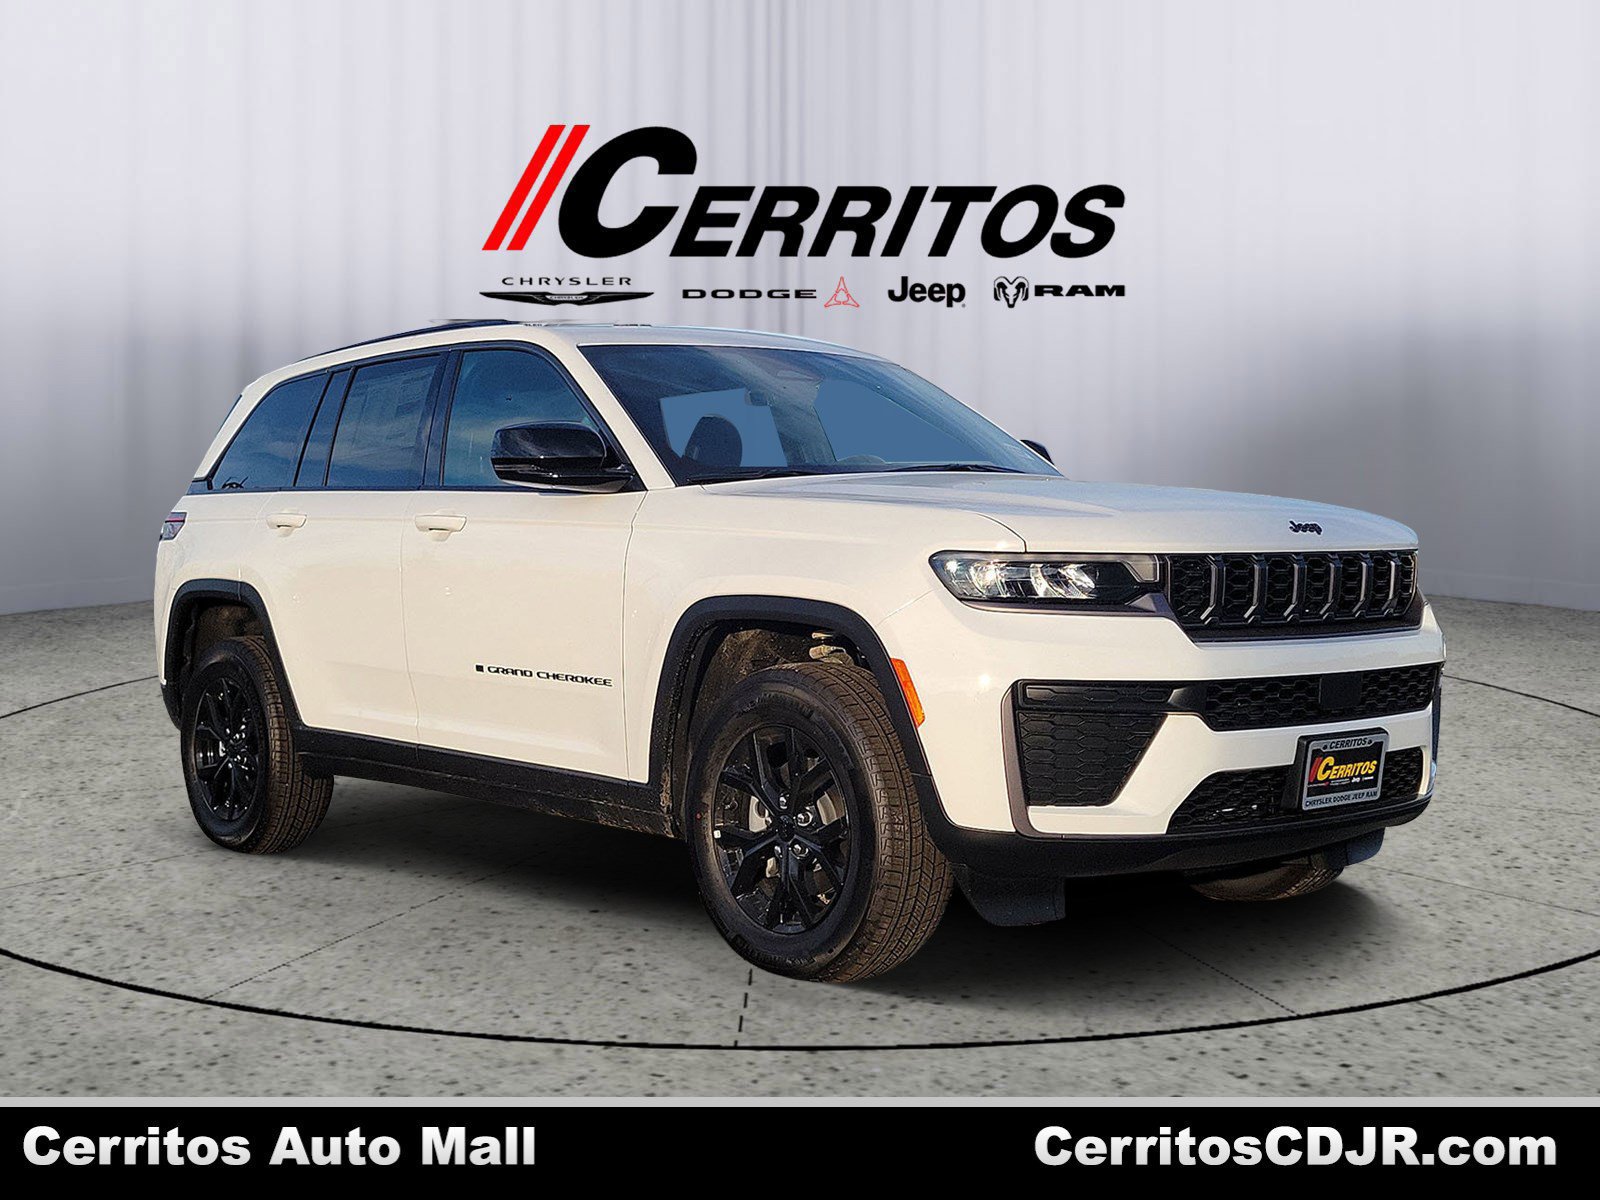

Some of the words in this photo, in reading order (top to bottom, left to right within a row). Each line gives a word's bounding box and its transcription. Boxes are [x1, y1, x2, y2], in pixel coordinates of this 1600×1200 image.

[1289, 520, 1323, 535] Jeep
[487, 665, 533, 678] GRAND
[536, 671, 612, 686] CHEROKEE
[1329, 738, 1367, 749] CERRITOS
[1317, 756, 1377, 780] CERRITOS
